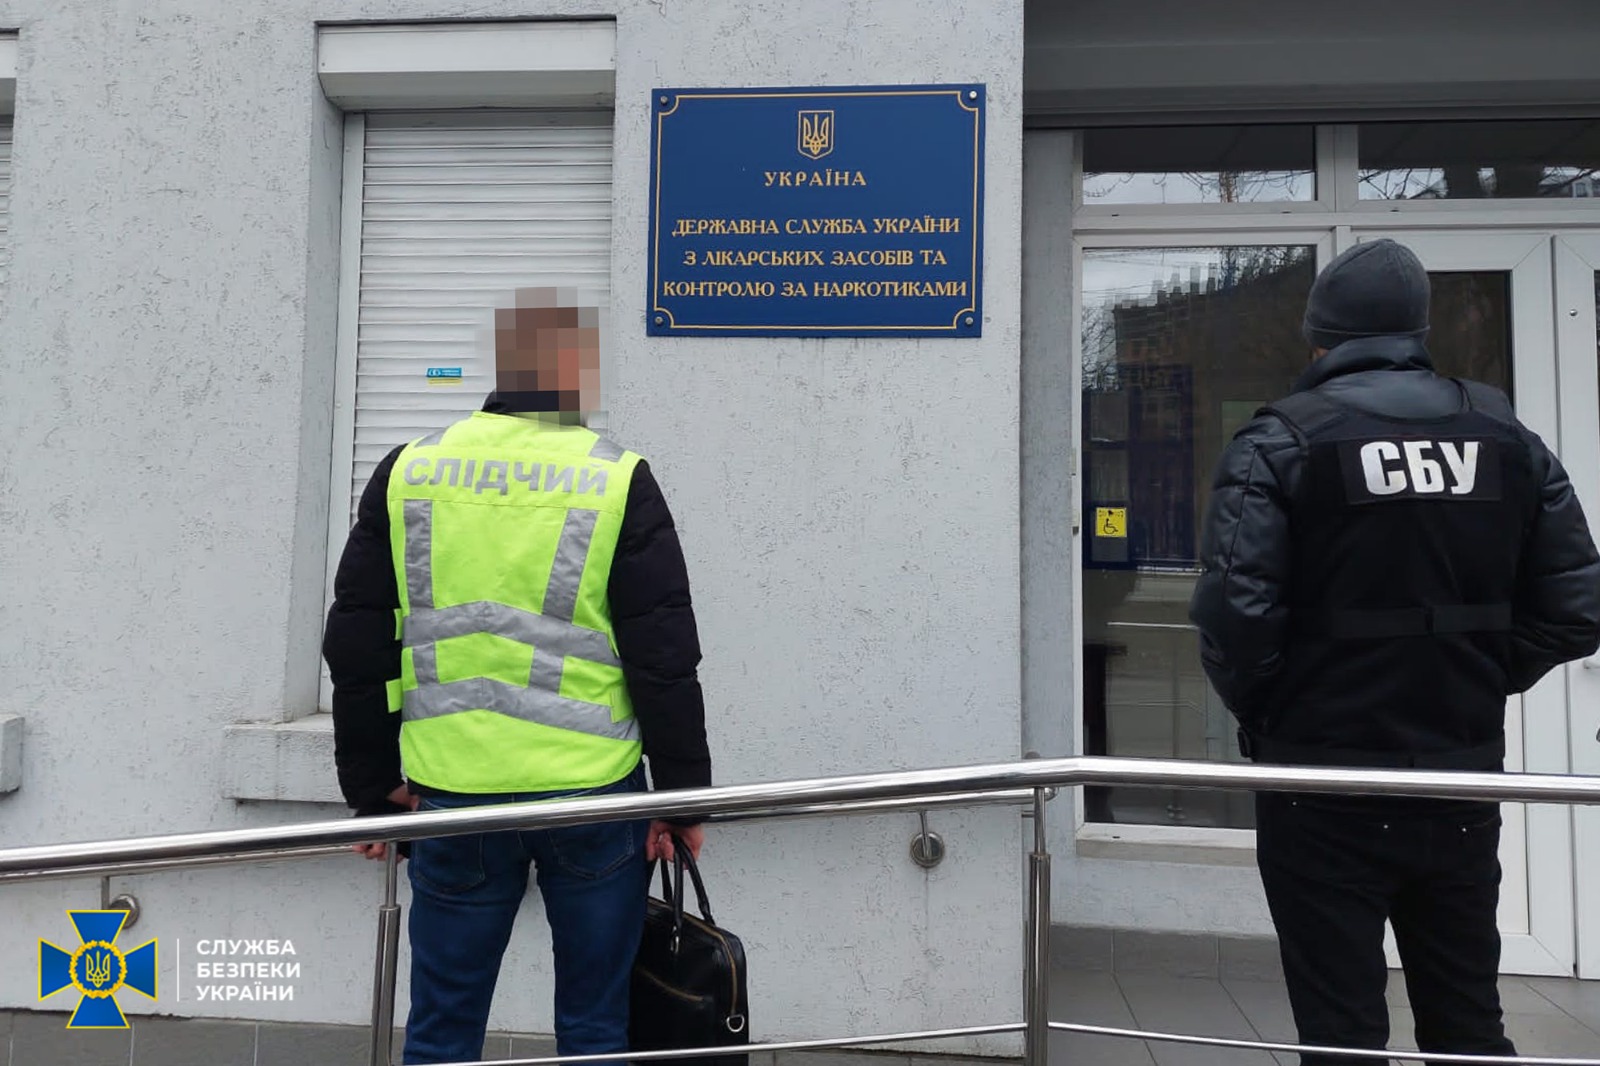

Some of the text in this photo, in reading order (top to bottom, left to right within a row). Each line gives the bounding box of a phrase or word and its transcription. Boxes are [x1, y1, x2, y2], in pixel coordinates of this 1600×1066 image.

[764, 168, 867, 187] УКРАЇНА
[671, 215, 961, 237] ДЕРЖАВНА СЛУЖБА УКРАЇНИ
[684, 249, 948, 266] З ЛІКАРСЬКИХ ЗАСОБІВ ТА
[663, 281, 967, 297] КОНТРОЛЮ ЗА НАРКОТИКАМИ
[403, 457, 608, 496] СЛІДЧИЙ
[1359, 440, 1480, 496] СБУ
